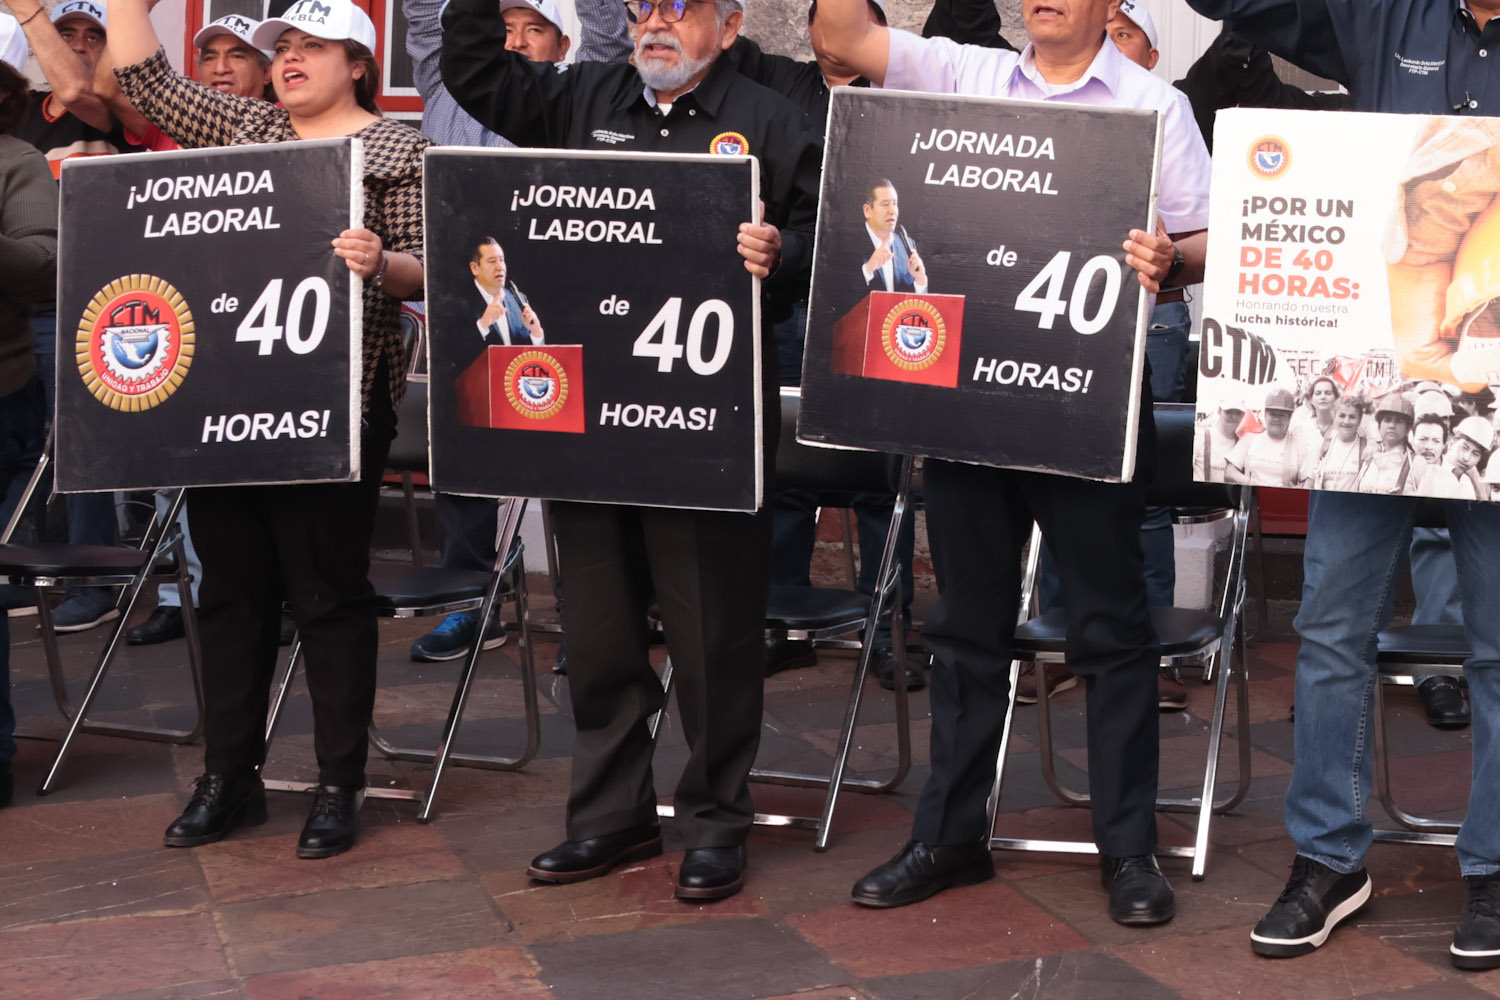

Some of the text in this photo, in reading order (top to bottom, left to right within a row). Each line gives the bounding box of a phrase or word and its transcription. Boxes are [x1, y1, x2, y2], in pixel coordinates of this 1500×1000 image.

[61, 1, 102, 18] CTM
[911, 129, 1054, 160] ¡JORNADA
[127, 170, 274, 209] ¡JORNADA
[925, 163, 1058, 195] LABORAL
[511, 185, 655, 211] ¡JORNADA
[1243, 196, 1353, 218] ¡POR UN
[144, 206, 280, 238] LABORAL
[529, 219, 662, 244] LABORAL
[1242, 223, 1345, 244] MÉXICO
[1240, 246, 1333, 271] DE 40
[987, 245, 1121, 334] de 40
[1239, 273, 1359, 300] HORAS:
[110, 300, 159, 327] CTM
[211, 277, 330, 355] de 40
[901, 313, 928, 327] CTM
[1235, 300, 1348, 315] Honrando nuestra
[1235, 313, 1338, 328] lucha histórica!
[600, 295, 734, 375] de 40
[101, 372, 128, 392] UNIDAD
[136, 368, 169, 392] TRABAJO
[522, 364, 549, 377] CTM
[973, 358, 1093, 393] HORAS!
[202, 410, 330, 442] HORAS!
[600, 403, 716, 430] HORAS!
